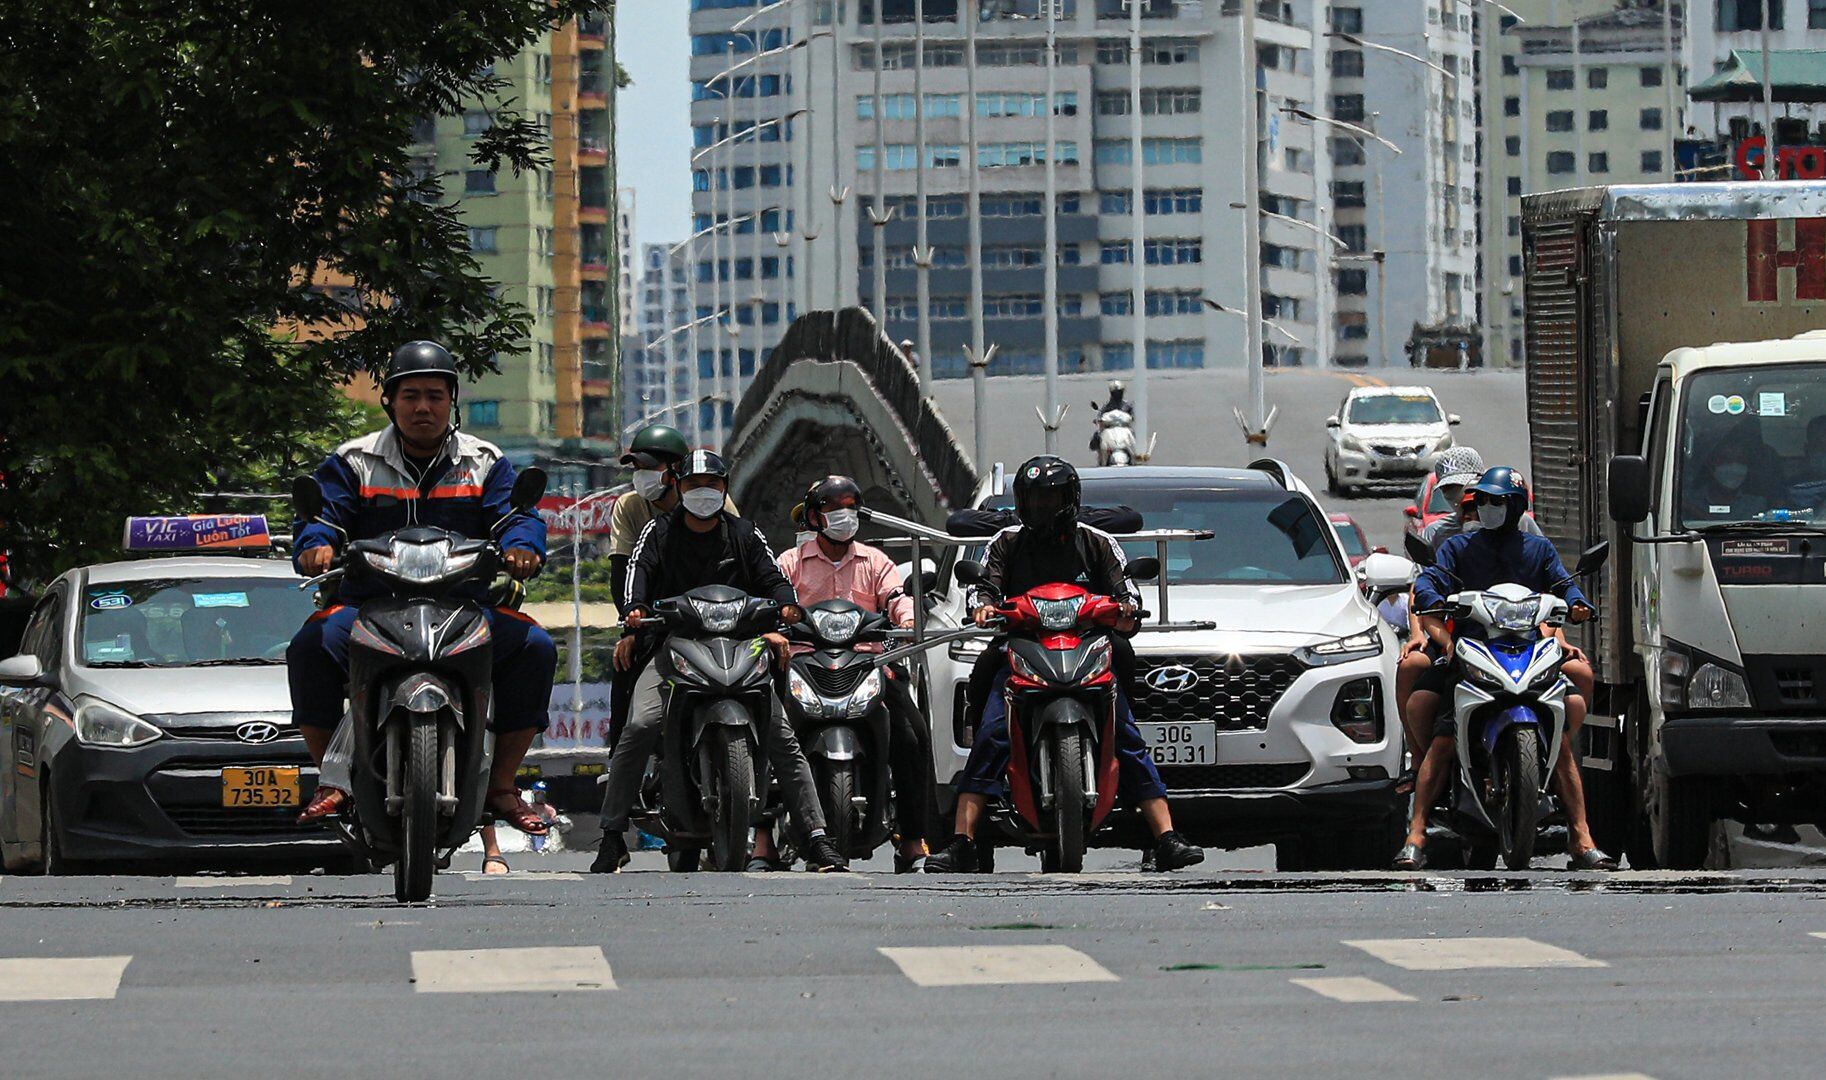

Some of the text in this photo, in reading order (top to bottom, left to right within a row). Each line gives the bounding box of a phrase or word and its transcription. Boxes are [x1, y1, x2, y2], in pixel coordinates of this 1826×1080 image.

[195, 529, 229, 545] Luôn
[1156, 725, 1192, 744] 30G
[244, 769, 278, 787] 30A
[230, 788, 292, 805] 735.32
